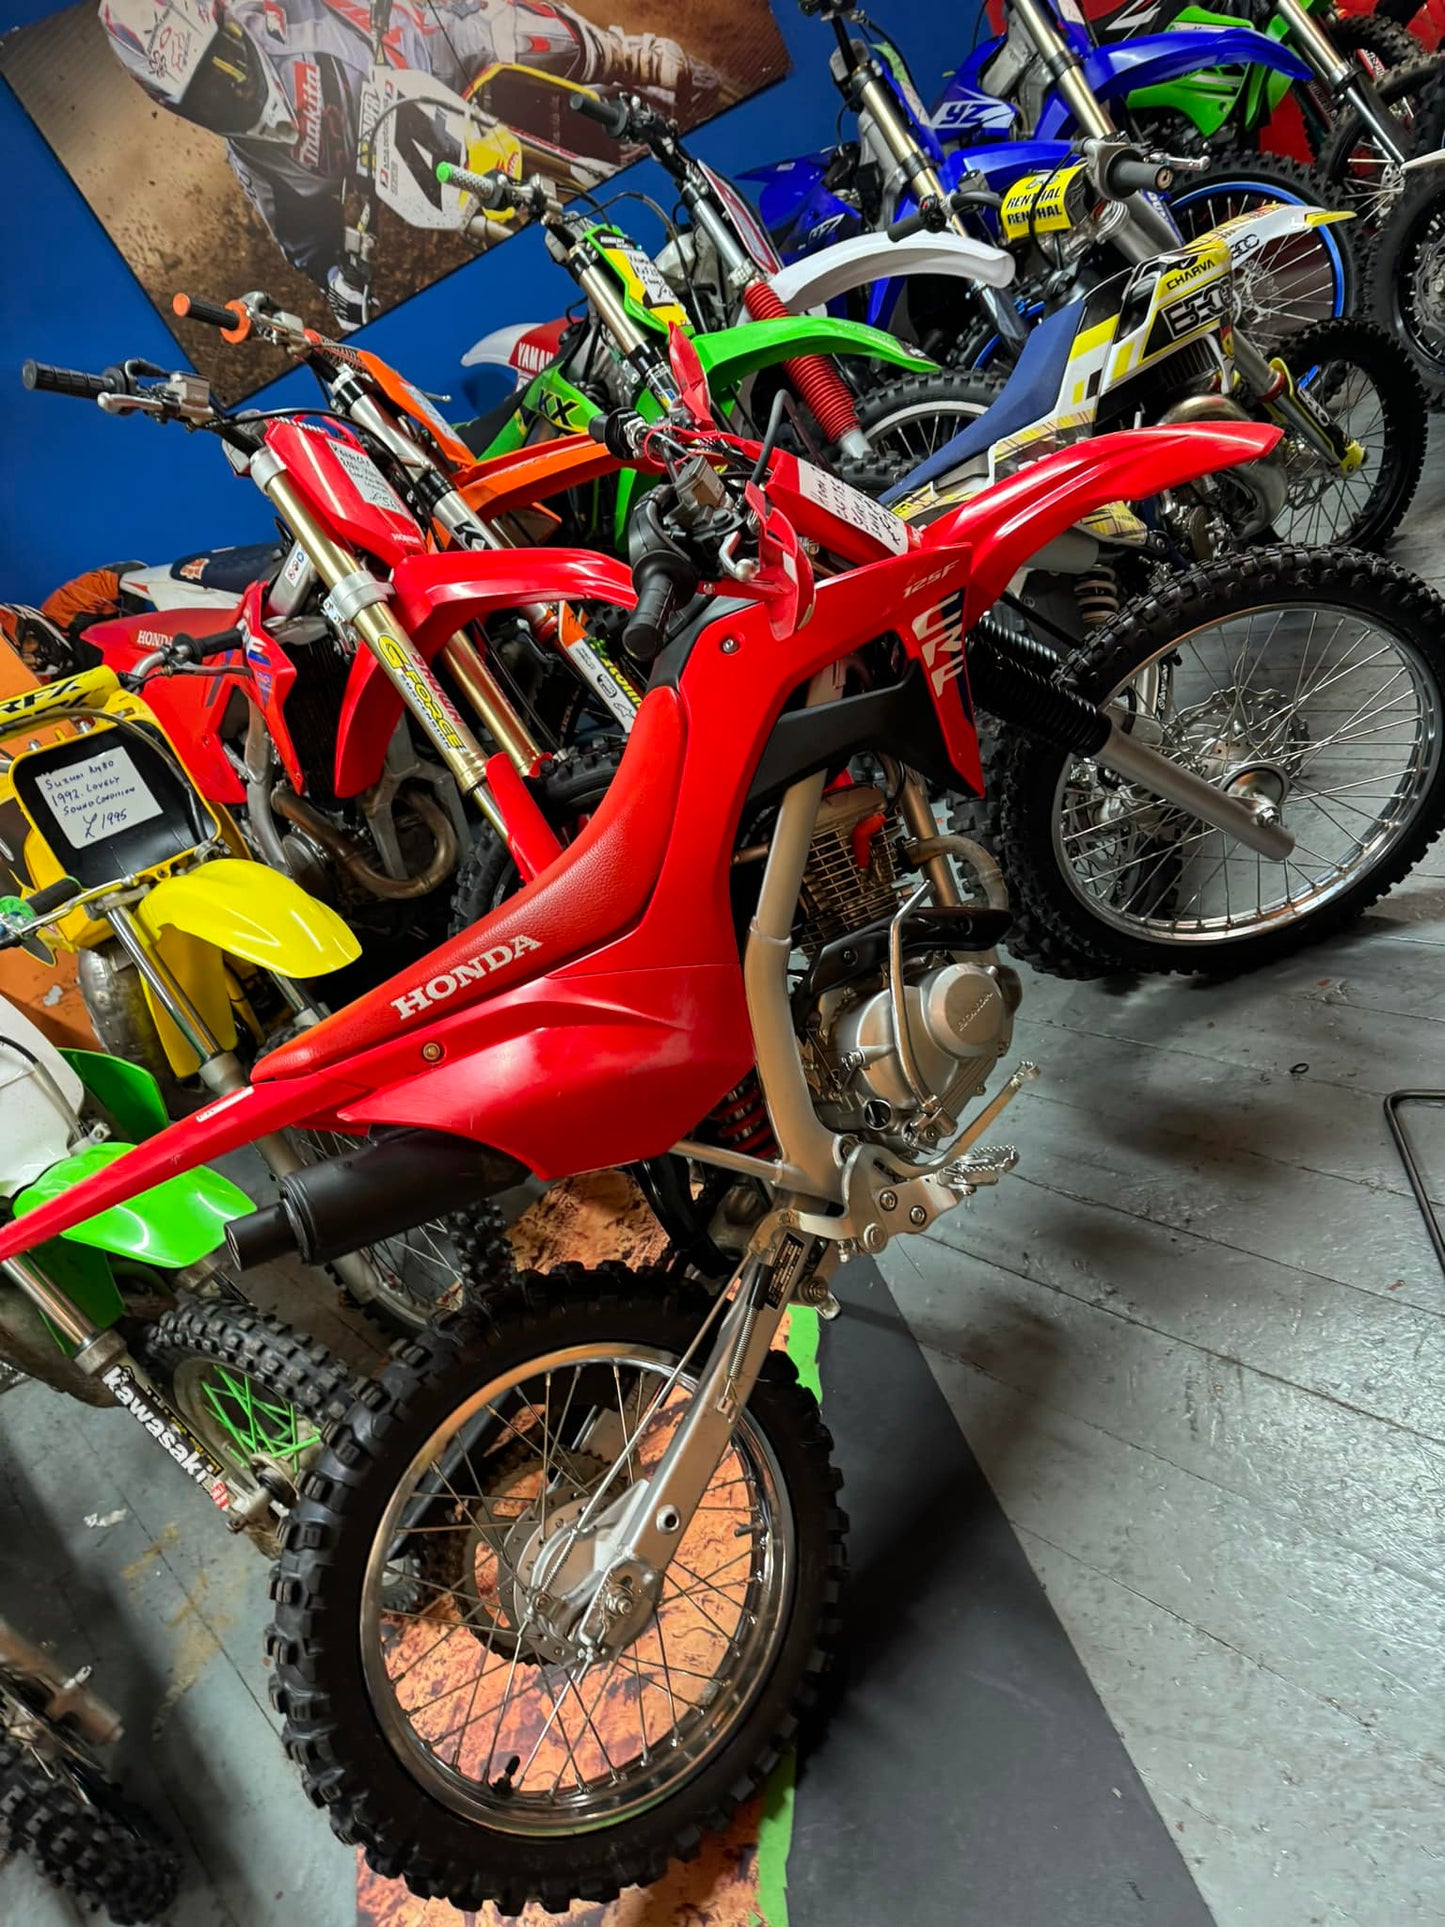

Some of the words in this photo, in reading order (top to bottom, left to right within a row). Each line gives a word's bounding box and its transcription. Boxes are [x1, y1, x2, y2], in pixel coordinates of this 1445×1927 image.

[1007, 205, 1062, 226] RENHAL
[1166, 259, 1215, 291] CHARVA
[903, 559, 960, 599] 125F
[911, 590, 965, 698] CRF
[390, 934, 543, 1020] HONDA
